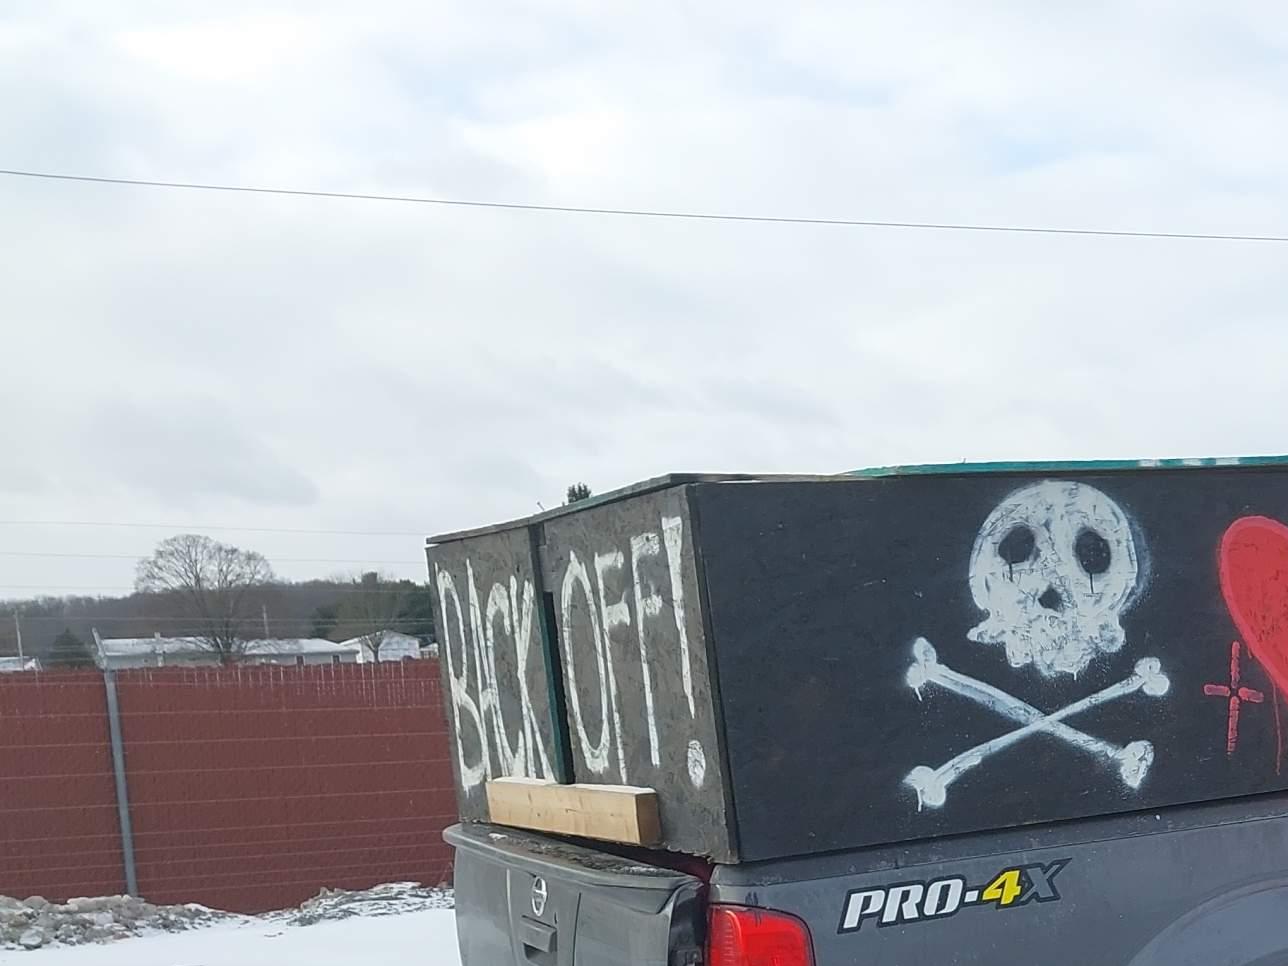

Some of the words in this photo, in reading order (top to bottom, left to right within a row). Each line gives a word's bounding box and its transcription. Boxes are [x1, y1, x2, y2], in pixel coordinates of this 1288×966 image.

[435, 558, 558, 798] BACK
[562, 517, 706, 788] OFF!
[838, 859, 1071, 933] PRO-4X
